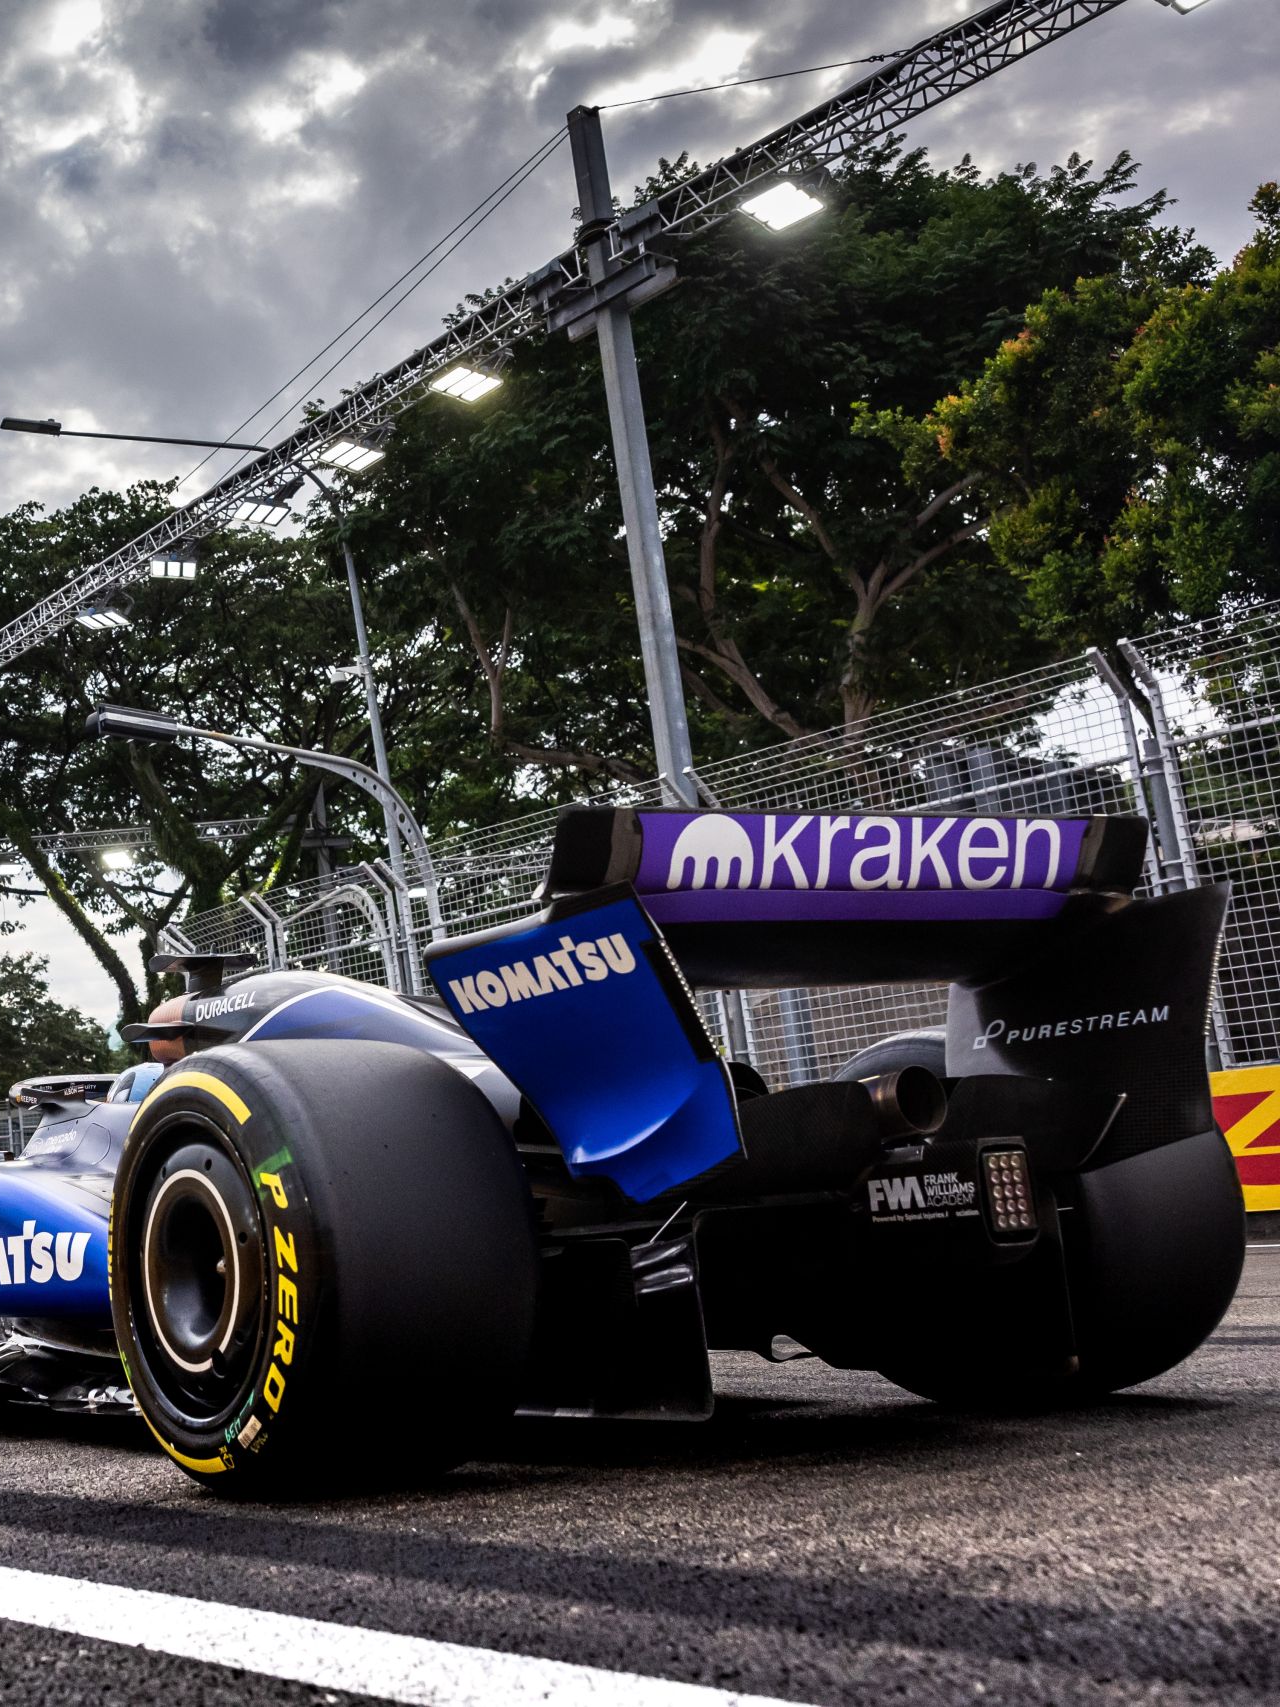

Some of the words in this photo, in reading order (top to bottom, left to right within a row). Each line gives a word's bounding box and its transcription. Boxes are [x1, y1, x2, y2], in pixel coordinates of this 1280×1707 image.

[448, 932, 636, 1014] KOMATSU
[195, 991, 256, 1022] DURACELL
[1006, 1005, 1169, 1044] PURESTREAM
[260, 1172, 288, 1209] P
[923, 1172, 958, 1185] FRANK
[924, 1182, 975, 1196] WILLIAMS
[927, 1194, 974, 1207] ACADEM
[263, 1225, 299, 1413] ZERO
